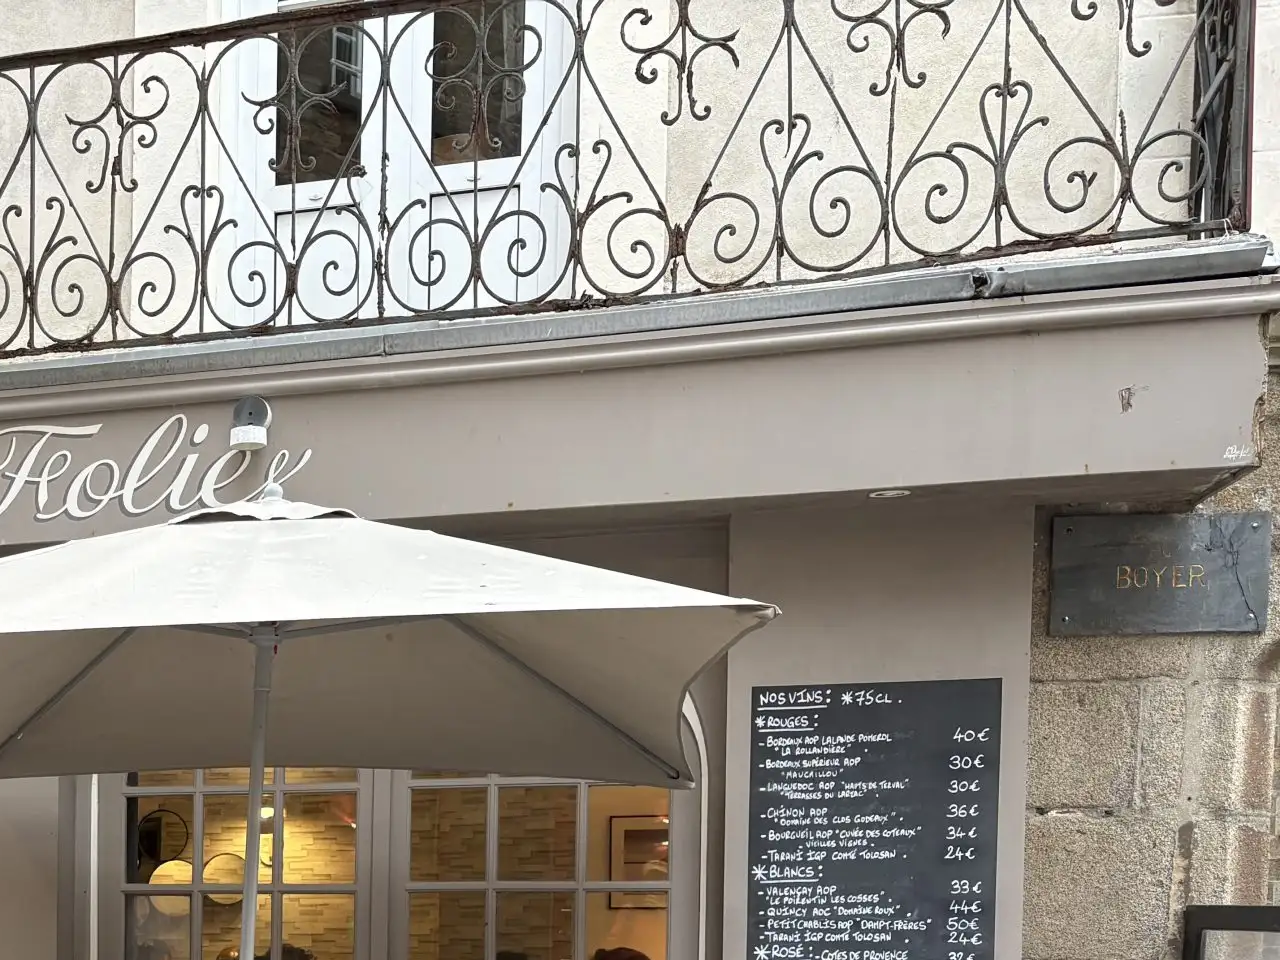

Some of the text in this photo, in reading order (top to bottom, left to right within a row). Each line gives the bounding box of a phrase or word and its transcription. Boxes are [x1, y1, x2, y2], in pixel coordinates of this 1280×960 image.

[760, 691, 786, 706] NOS
[766, 727, 989, 747] BORDEAUX AOP LALANDE POMEROL 40€
[765, 759, 801, 769] BORDEAUX
[843, 757, 861, 767] AOP
[948, 754, 985, 769] 30€
[767, 781, 814, 792] LANGUEDOC
[818, 780, 836, 790] AOP
[947, 780, 981, 793] 30€
[824, 791, 834, 799] DU
[810, 807, 828, 817] AOP
[946, 804, 980, 818] 36€
[813, 817, 829, 825] DES
[832, 815, 851, 824] CLOS
[816, 829, 833, 839] AOP
[865, 829, 881, 838] DES
[945, 826, 977, 839] 34€
[806, 849, 827, 861] IGP
[859, 849, 897, 859] TOLOSAN
[944, 846, 975, 861] 24€
[816, 885, 837, 895] AOP
[950, 880, 982, 894] 33€
[830, 895, 845, 903] LES
[767, 905, 808, 917] QUINCY
[949, 900, 982, 913] 44€
[768, 917, 795, 929] PETIT
[796, 919, 836, 929] CHABLIS
[836, 920, 851, 930] AOP
[946, 916, 980, 930] 50€
[804, 929, 823, 942] IGP
[852, 932, 891, 942] TOLOSAN
[947, 932, 983, 946] 24€
[849, 952, 860, 960] DE
[863, 949, 909, 960] PROVENCE
